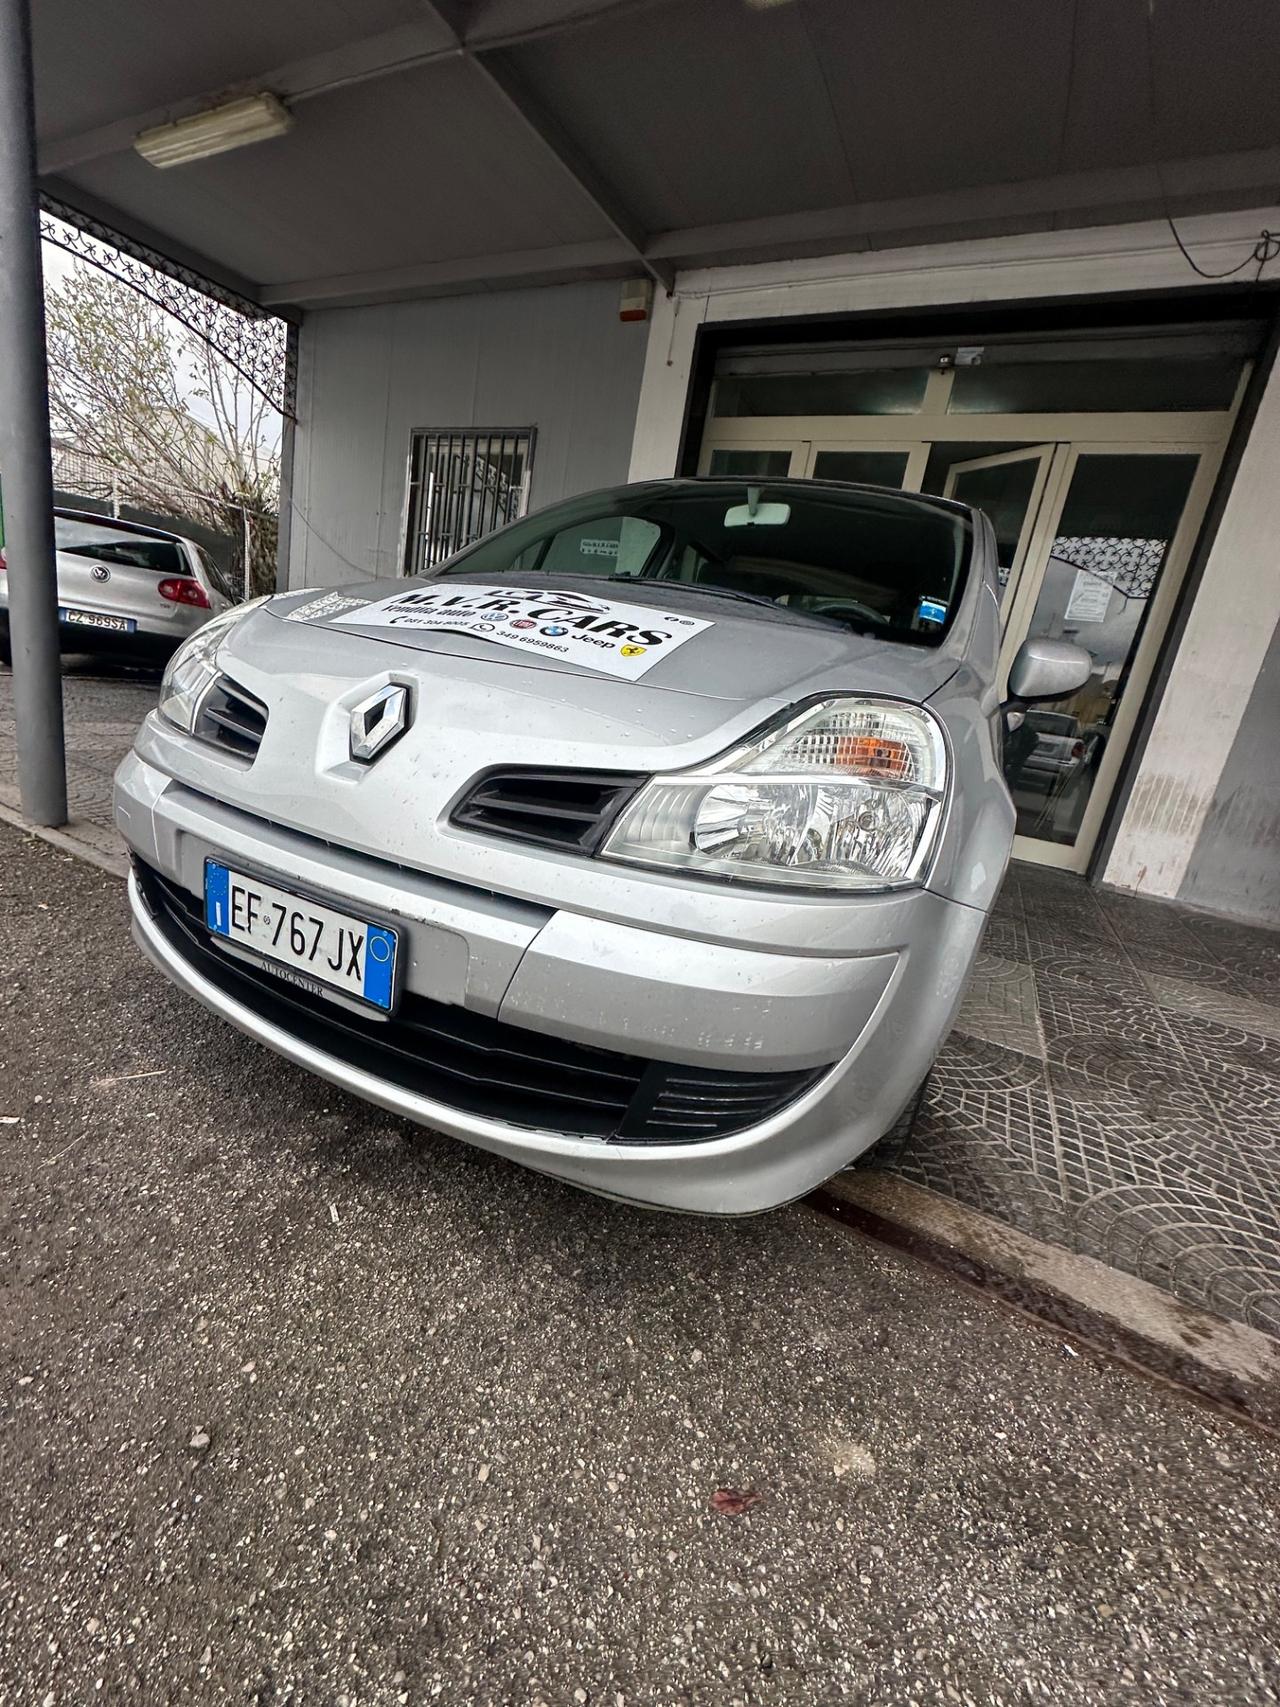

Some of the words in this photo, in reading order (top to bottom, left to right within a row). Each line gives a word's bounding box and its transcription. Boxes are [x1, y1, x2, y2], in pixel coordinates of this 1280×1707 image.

[391, 594, 520, 614] M.V.R.
[527, 608, 673, 646] CARS
[437, 608, 477, 617] auto
[496, 630, 519, 640] 349
[519, 636, 570, 653] 6959863
[571, 634, 616, 649] Jeep
[231, 885, 261, 935] EF
[271, 902, 324, 961] 767
[327, 927, 364, 982] JX
[261, 961, 324, 997] AUTOCENTER
